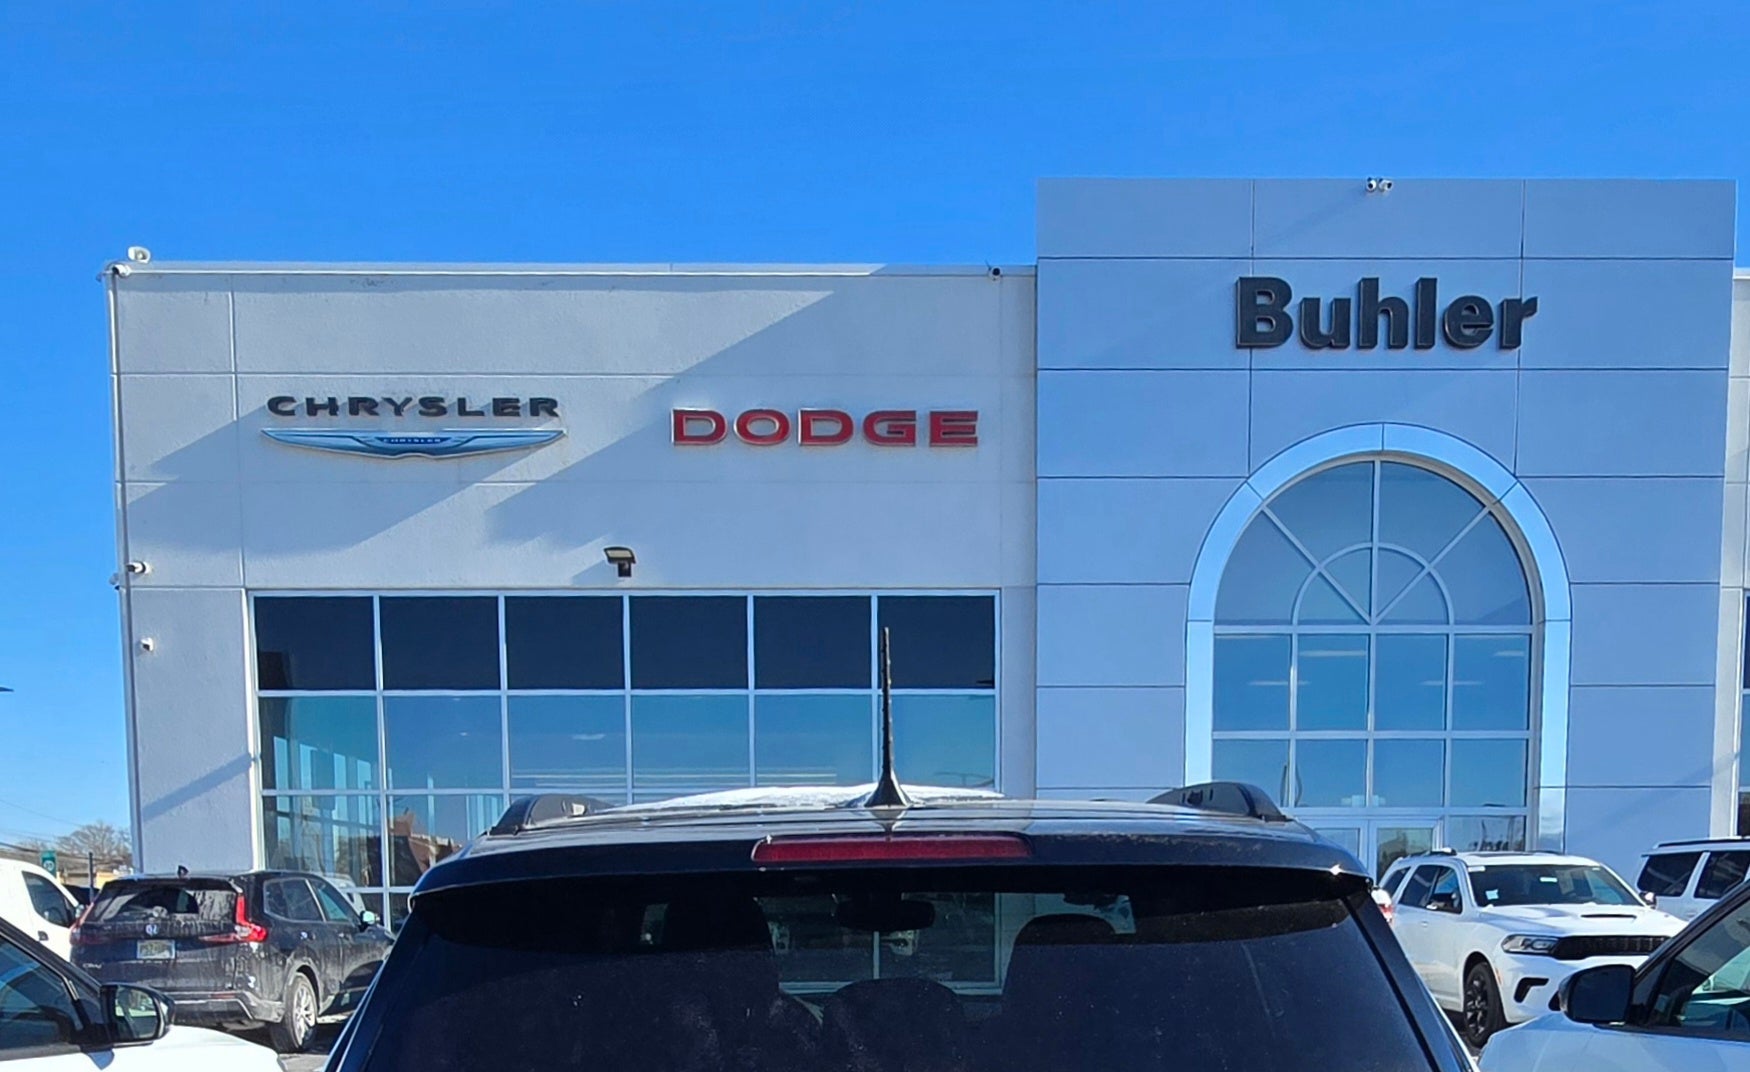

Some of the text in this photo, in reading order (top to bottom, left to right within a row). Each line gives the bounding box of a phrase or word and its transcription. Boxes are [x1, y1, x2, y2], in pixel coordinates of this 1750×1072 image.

[1235, 276, 1539, 350] Buhler
[267, 396, 559, 417] CHRYSLER
[671, 408, 978, 447] DODGE
